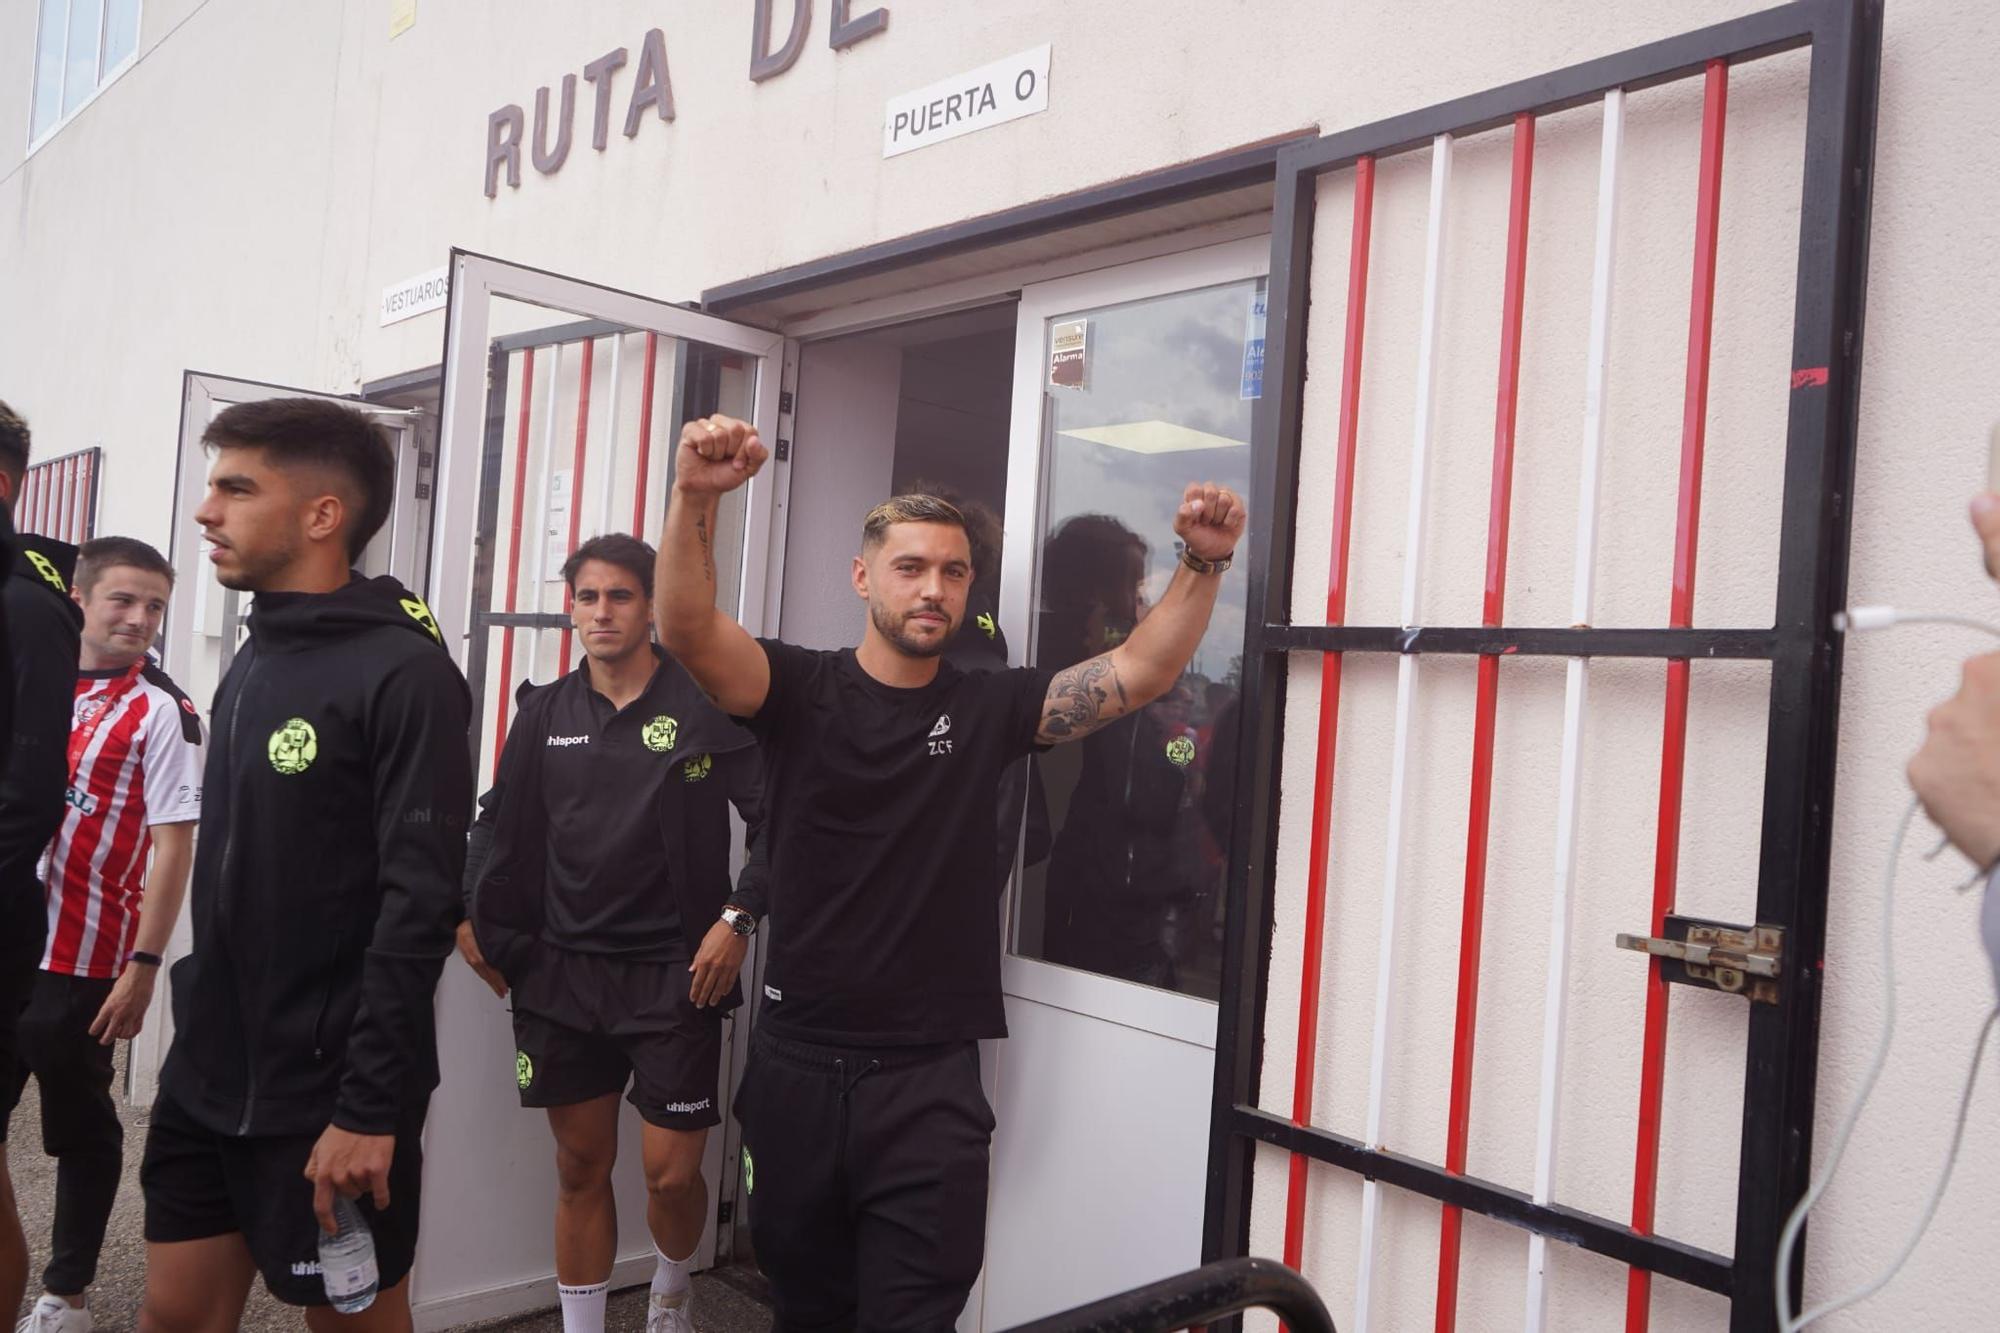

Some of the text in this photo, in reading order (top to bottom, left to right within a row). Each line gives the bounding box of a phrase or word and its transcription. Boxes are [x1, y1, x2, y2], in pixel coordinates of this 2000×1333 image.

[484, 27, 676, 199] RUTA
[893, 83, 997, 142] PUERTA
[1053, 352, 1083, 364] Alarma
[666, 1097, 710, 1114] uhlsport
